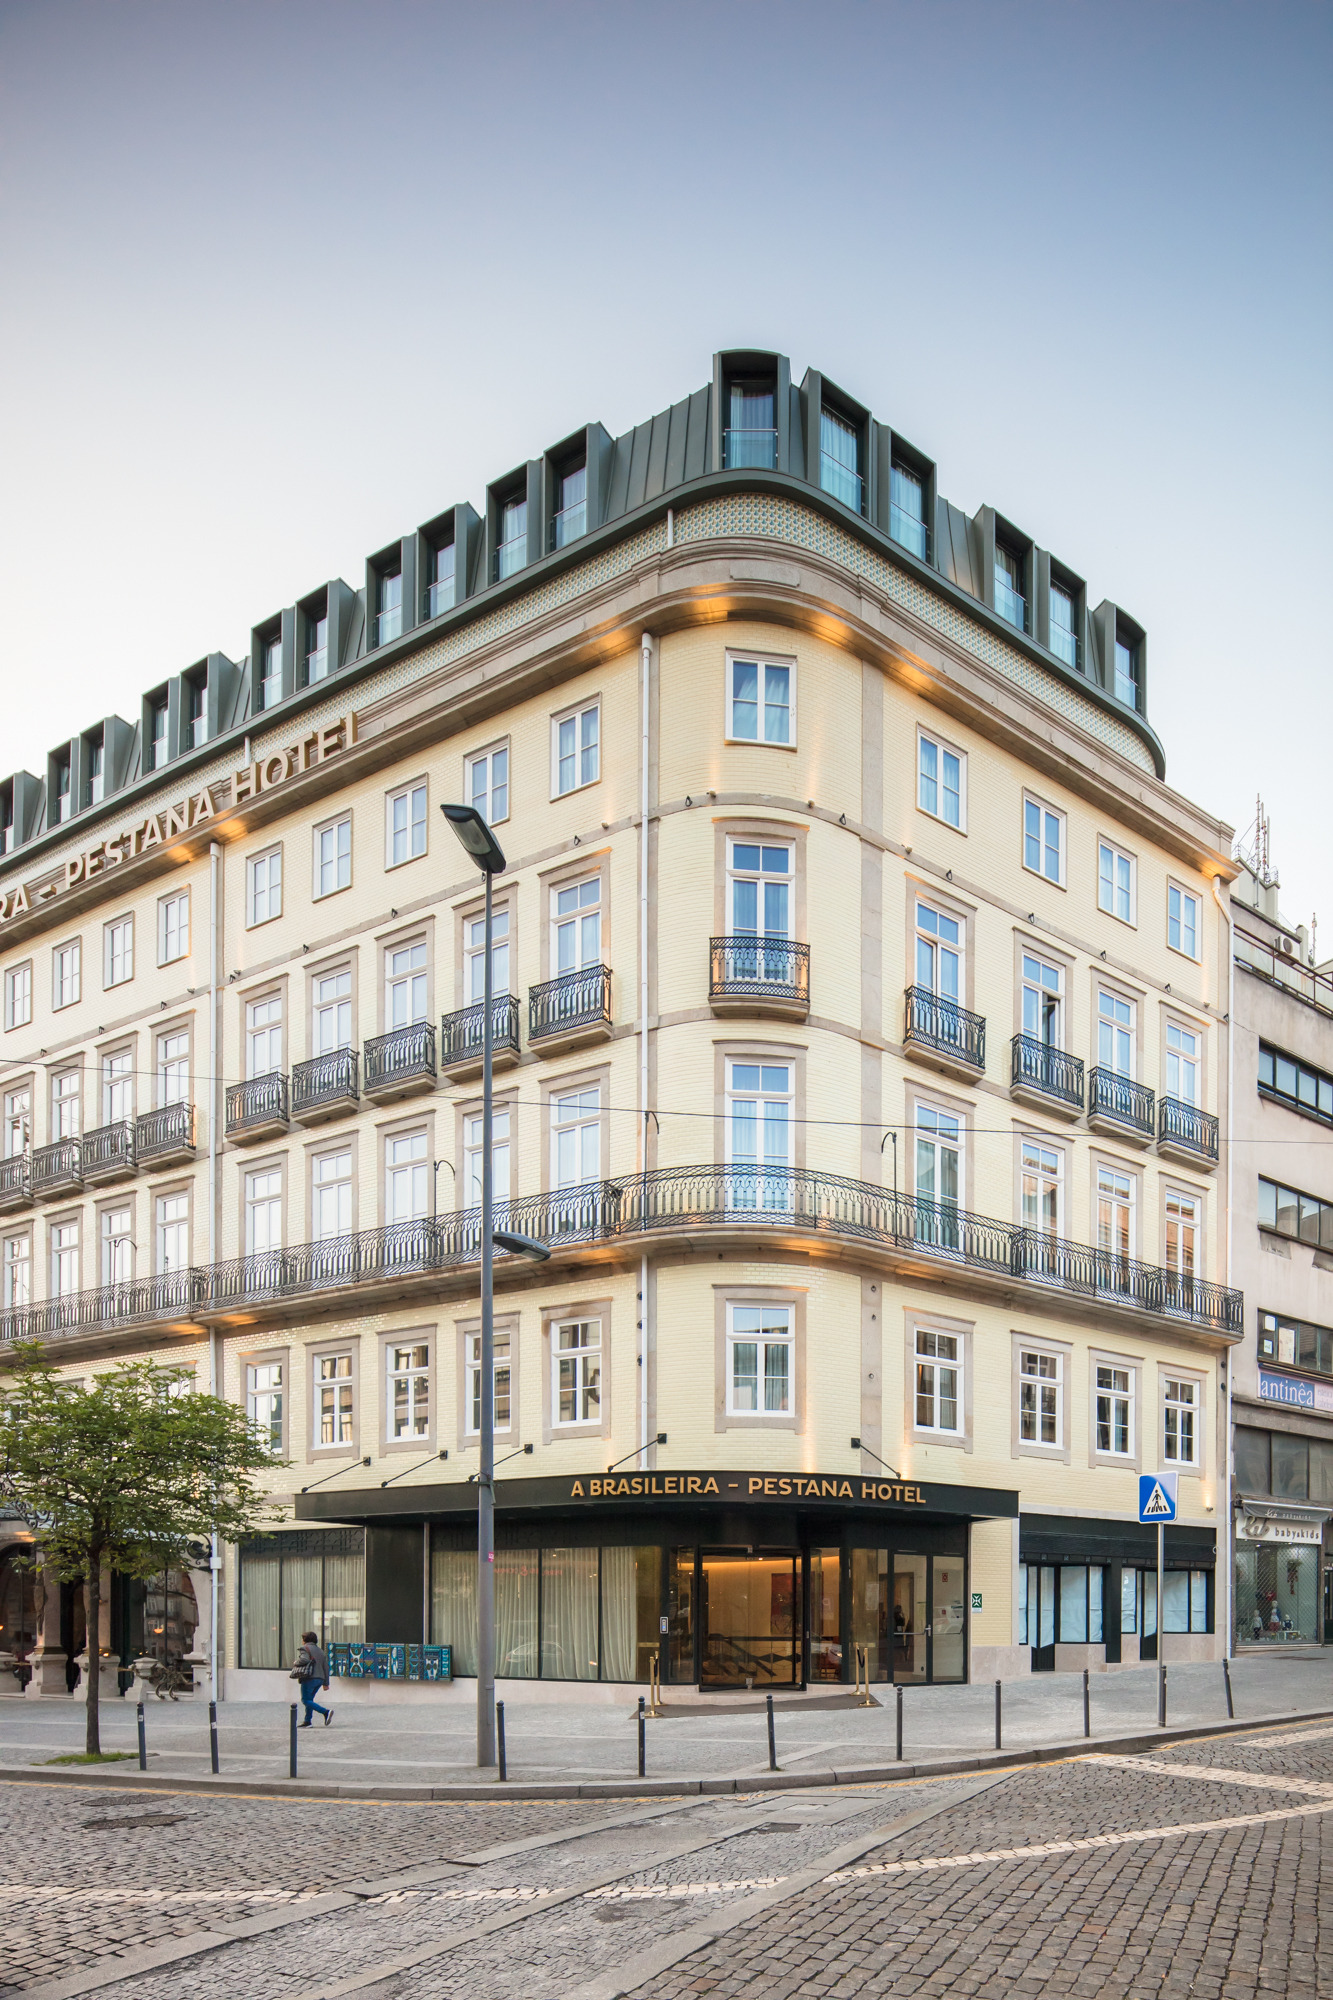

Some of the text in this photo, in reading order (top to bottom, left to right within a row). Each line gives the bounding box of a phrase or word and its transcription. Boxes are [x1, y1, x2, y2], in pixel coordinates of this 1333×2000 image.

[65, 787, 217, 889] PESTANA
[1261, 1380, 1314, 1406] antinêa
[570, 1480, 585, 1497] A
[589, 1476, 720, 1497] BRASILEIRA
[748, 1477, 854, 1498] PESTANA
[861, 1483, 927, 1504] HOTEL
